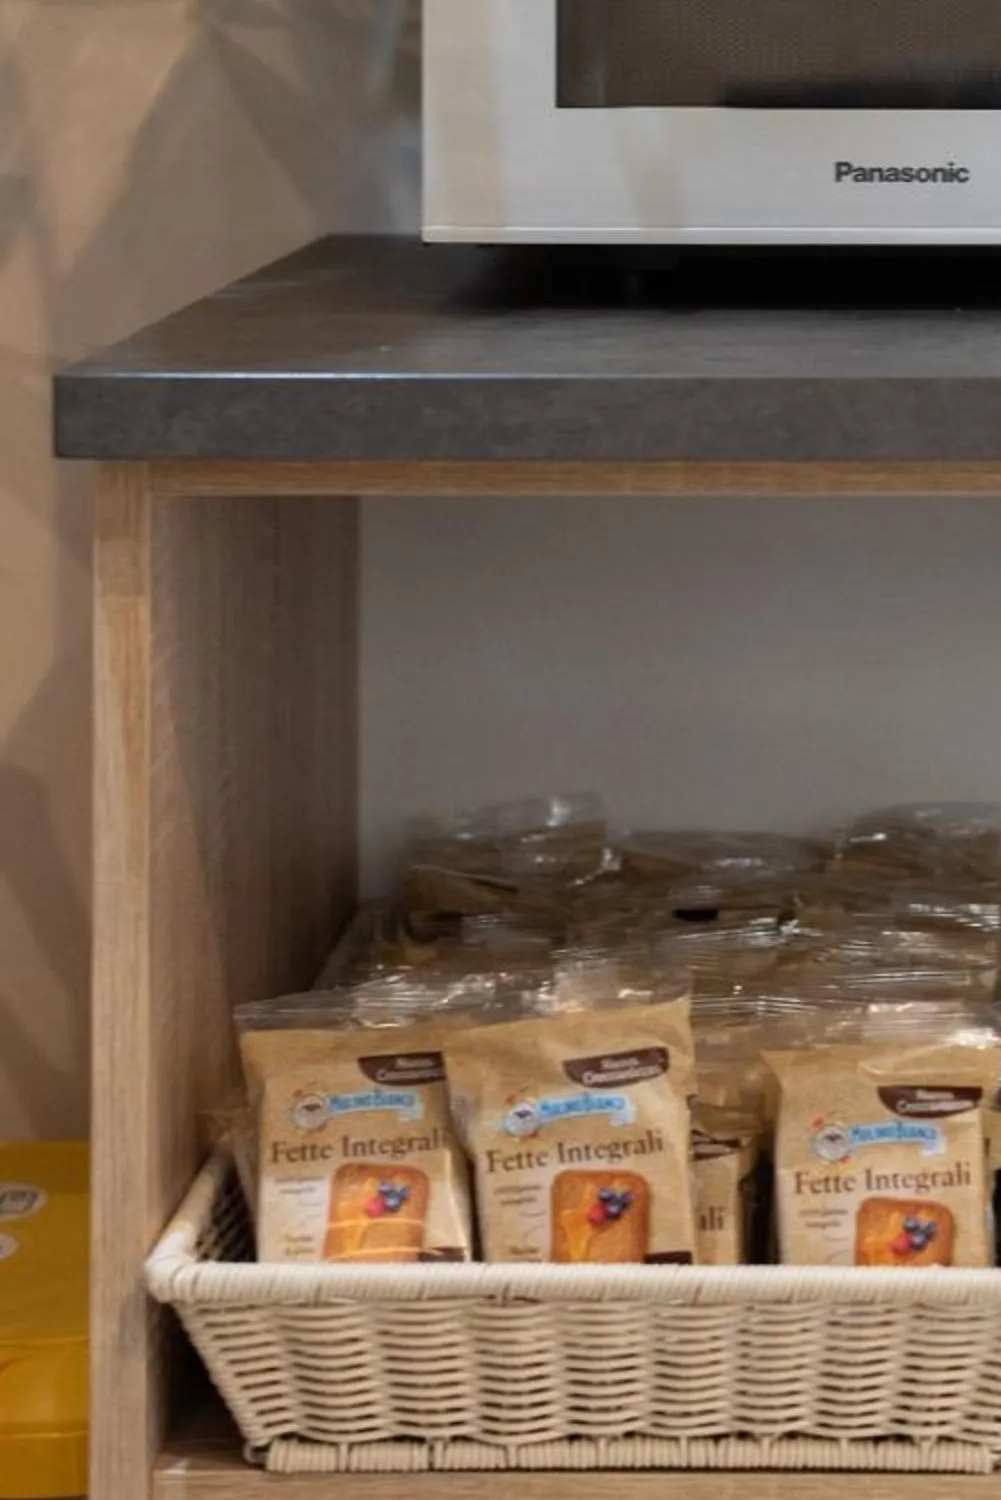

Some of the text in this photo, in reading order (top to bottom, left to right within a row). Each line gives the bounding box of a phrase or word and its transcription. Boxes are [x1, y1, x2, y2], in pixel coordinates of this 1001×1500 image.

[834, 161, 970, 183] Panasonic
[271, 1140, 333, 1163] Fette
[486, 1129, 665, 1174] Fette Integrali
[794, 1160, 972, 1195] Fette Integrali
